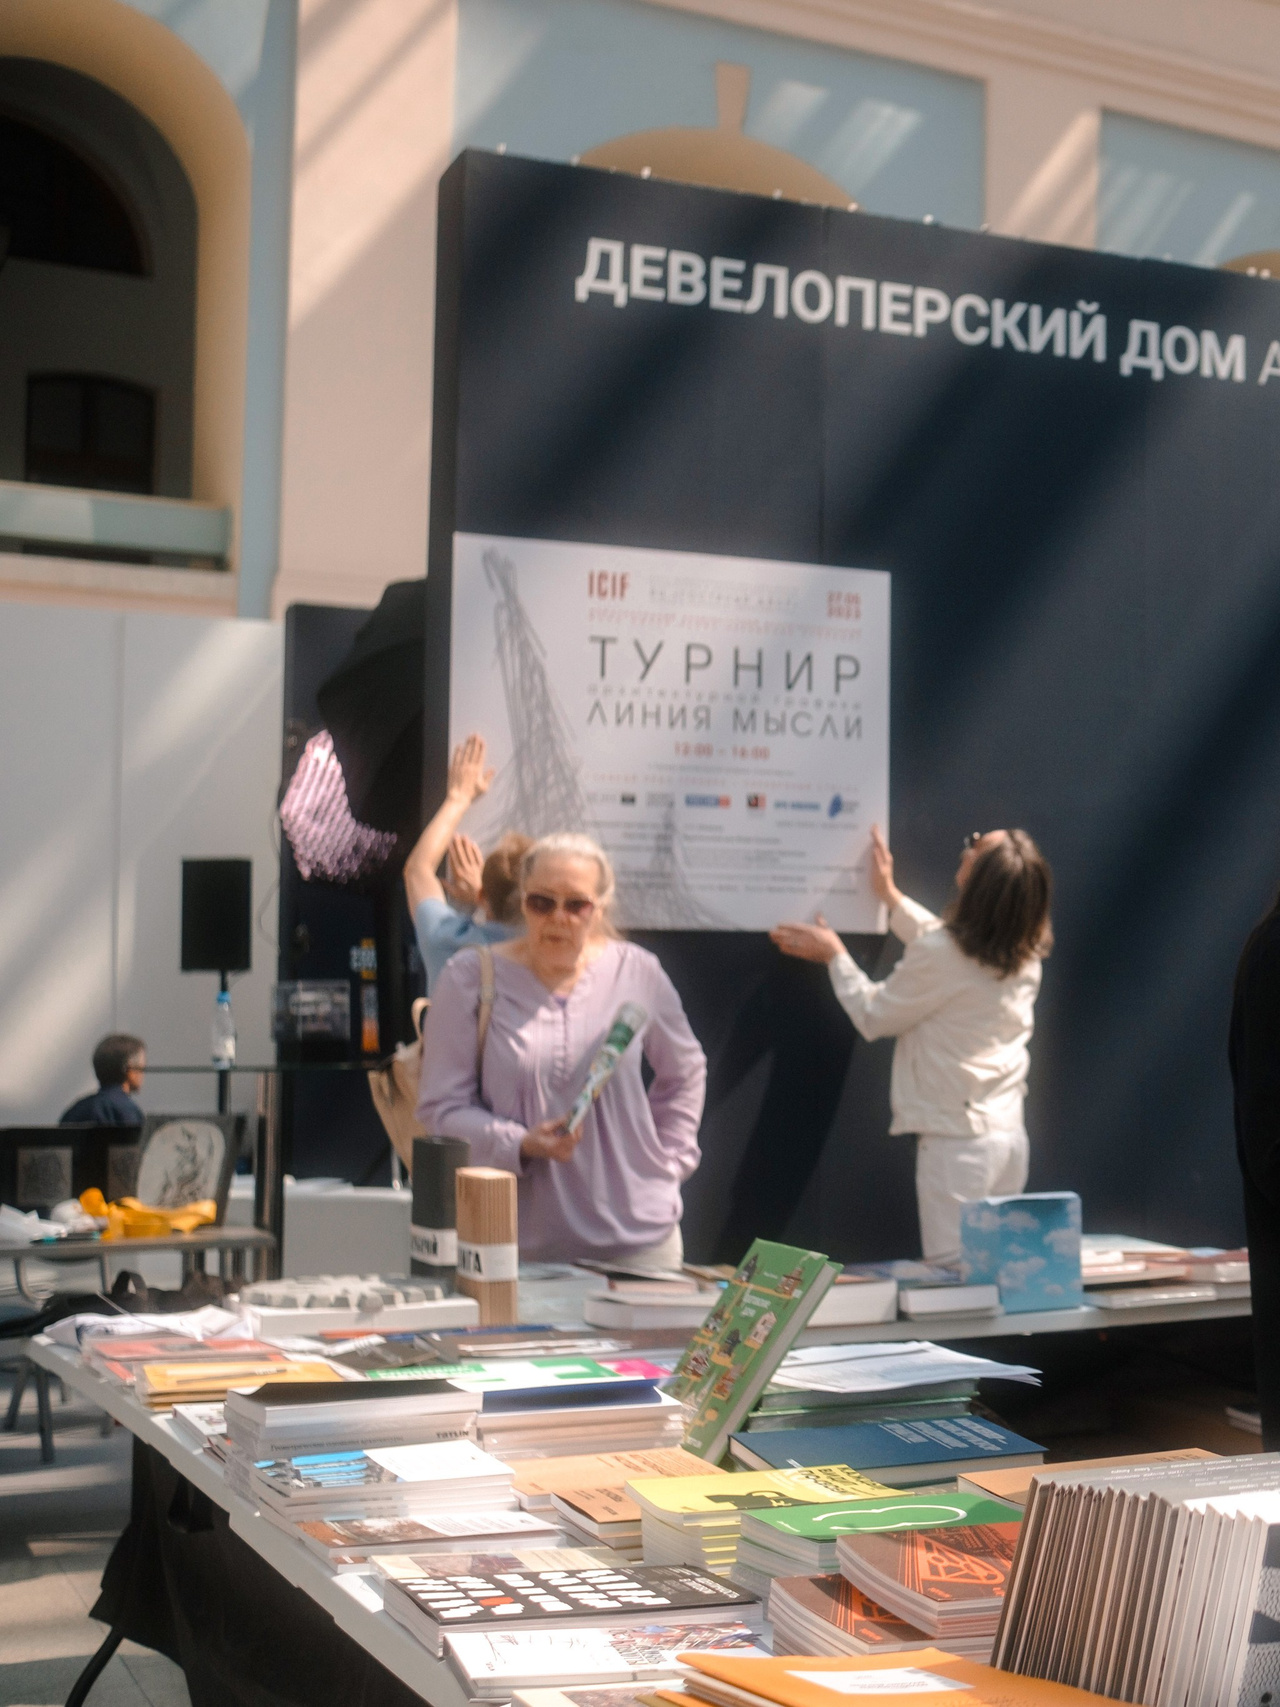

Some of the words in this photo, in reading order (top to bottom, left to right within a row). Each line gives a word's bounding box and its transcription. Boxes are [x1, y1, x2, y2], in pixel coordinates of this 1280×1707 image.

[574, 236, 1108, 363] ДЕВЕЛОПЕРСКИЙ
[1119, 318, 1247, 382] ДОМ
[588, 570, 631, 600] ICIF
[588, 635, 862, 695] ТУРНИР
[586, 701, 712, 731] ЛИНИЯ
[731, 707, 864, 741] МЫСЛИ
